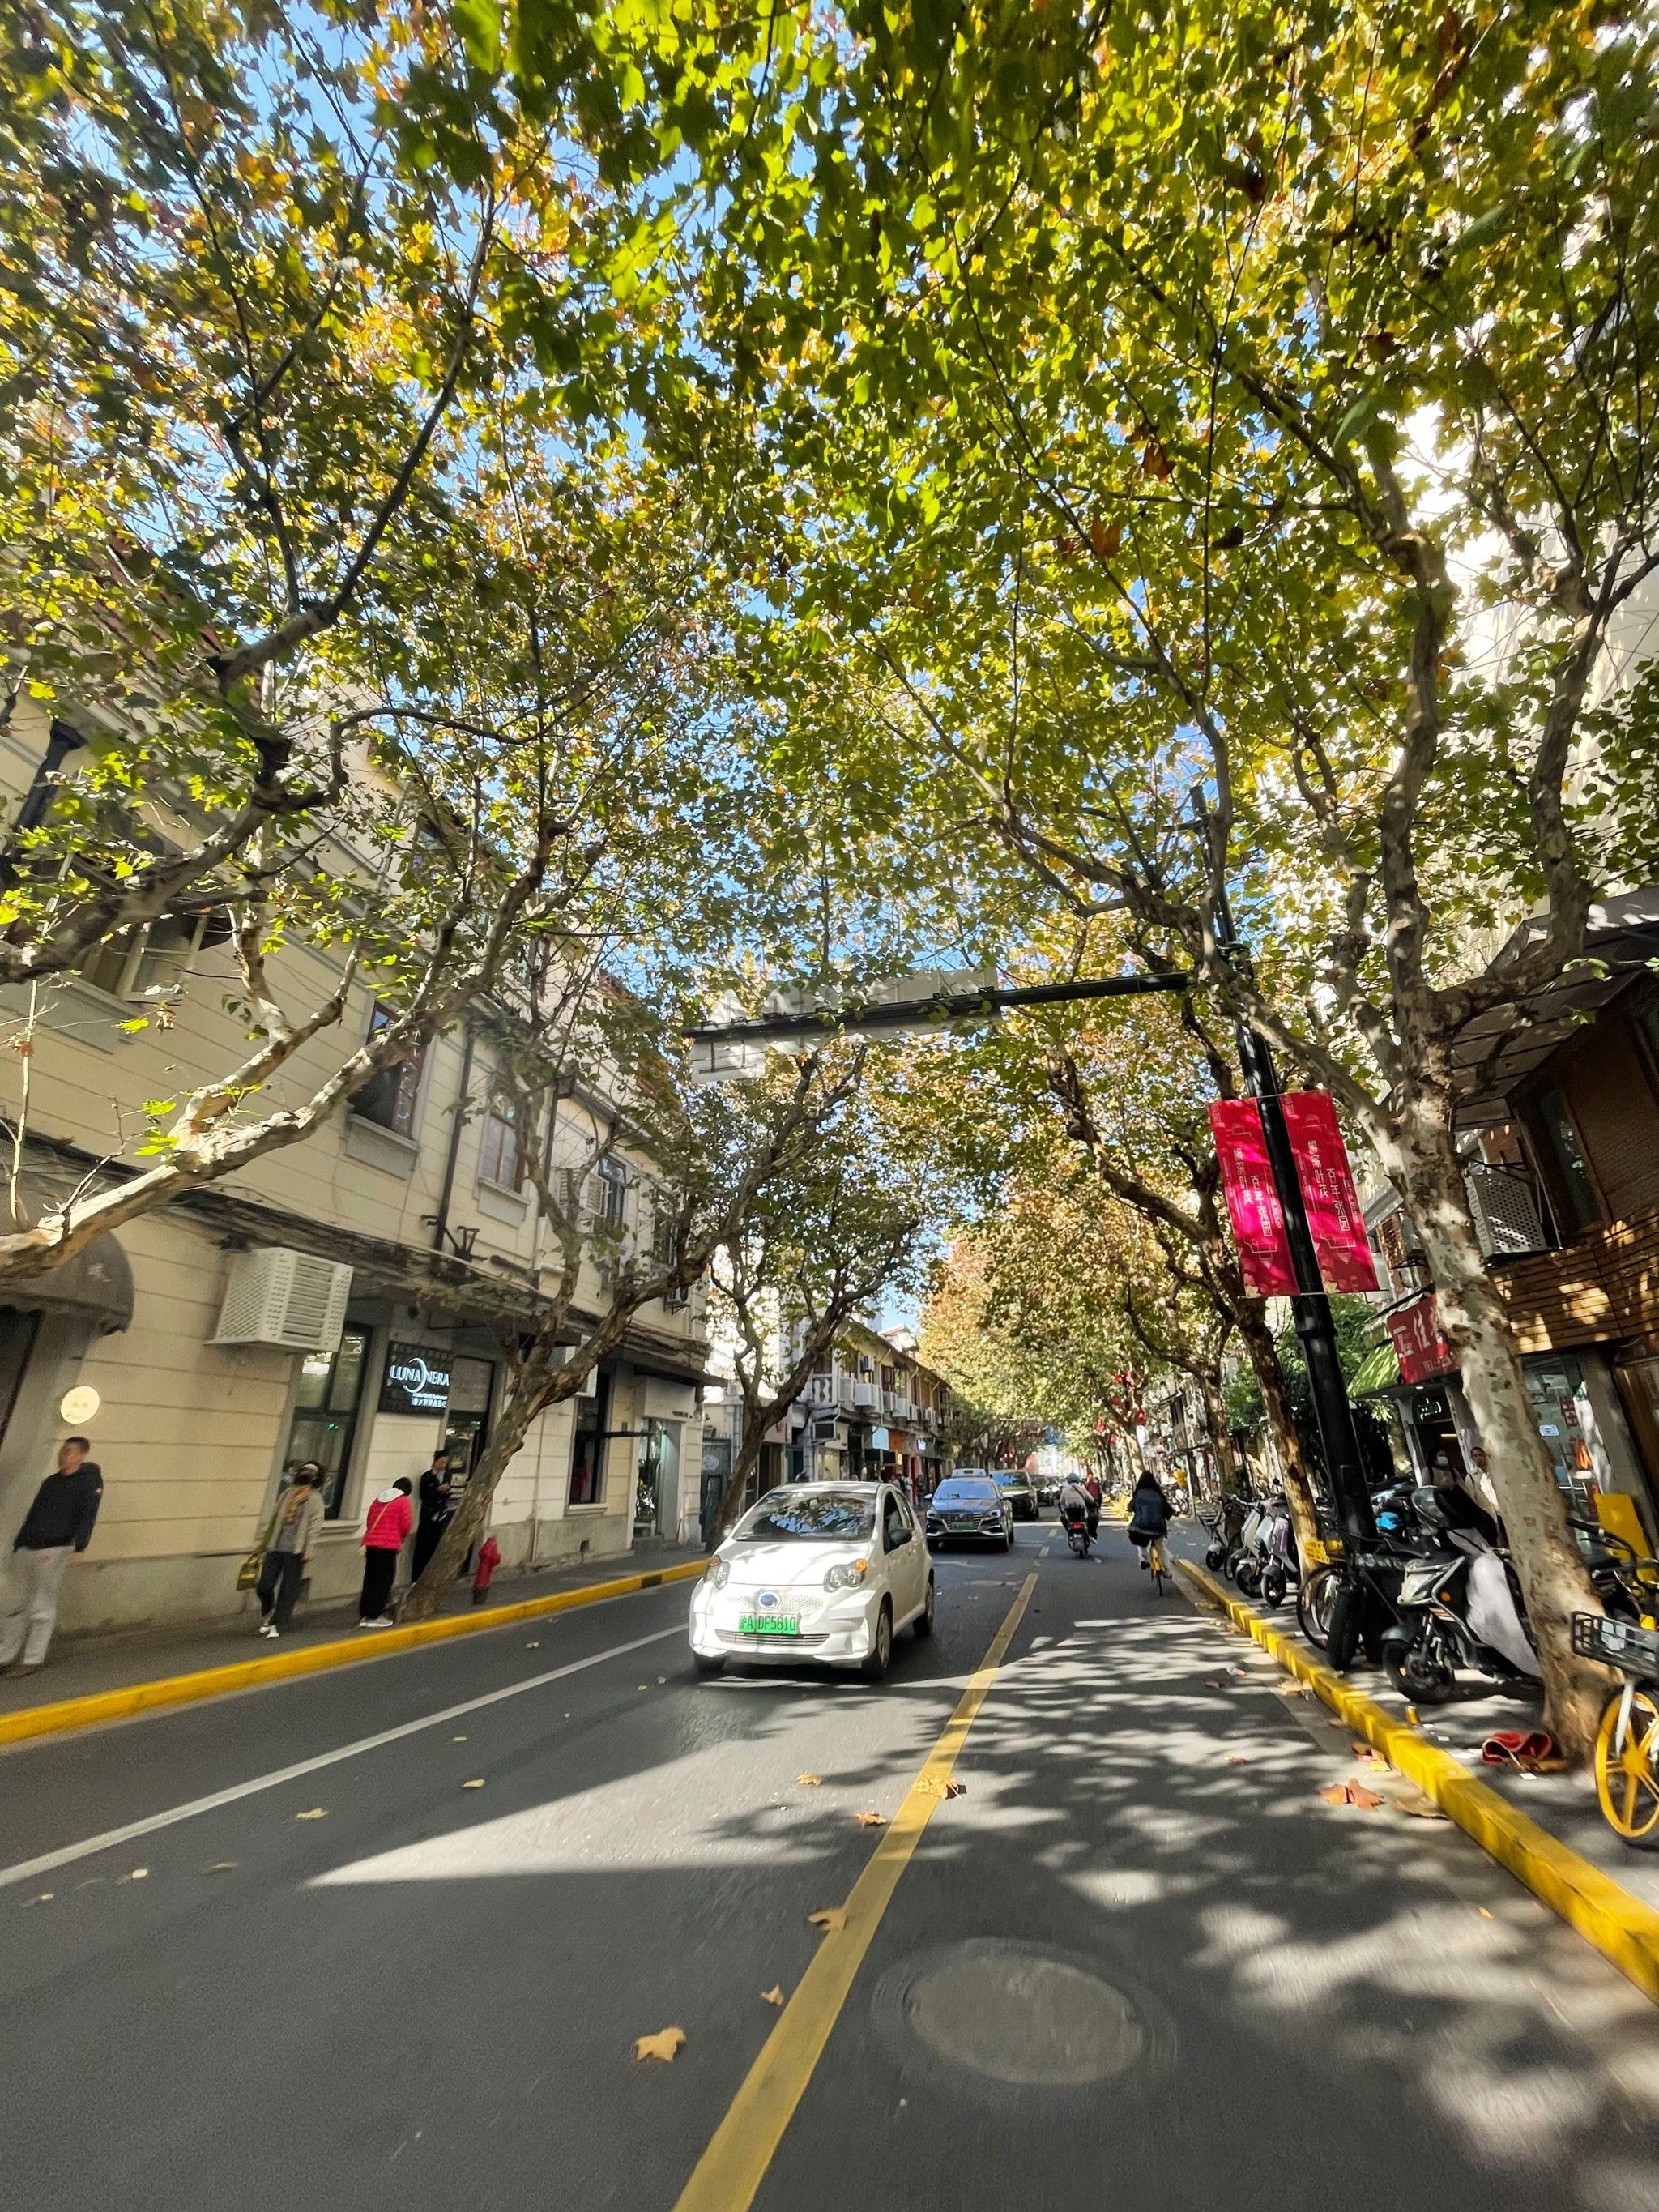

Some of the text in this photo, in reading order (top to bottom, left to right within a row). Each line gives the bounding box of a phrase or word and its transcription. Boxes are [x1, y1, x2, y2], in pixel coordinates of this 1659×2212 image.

[1251, 1175, 1273, 1236] 百年张园
[1326, 1168, 1350, 1231] 百年张园
[390, 1364, 421, 1382] LUNA
[757, 1616, 796, 1631] DF5610
